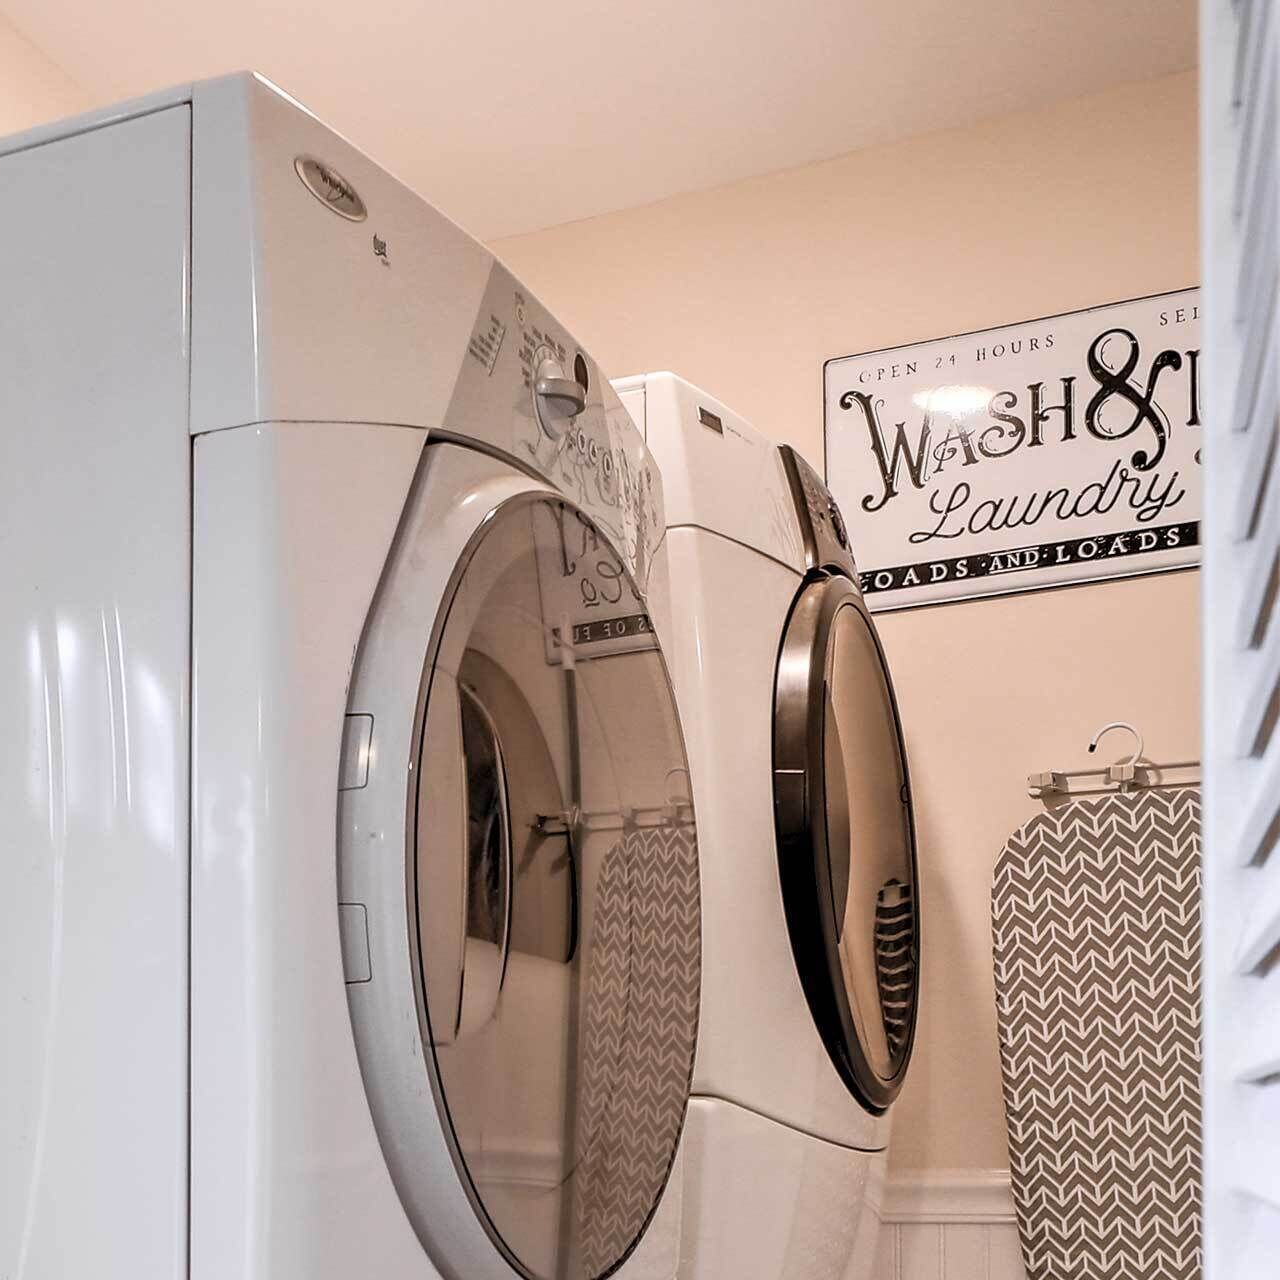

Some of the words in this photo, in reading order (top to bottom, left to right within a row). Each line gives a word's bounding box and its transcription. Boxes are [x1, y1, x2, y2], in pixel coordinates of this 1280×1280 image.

[858, 361, 919, 384] OPEN
[935, 354, 957, 370] 24
[975, 333, 1057, 362] HOURS
[839, 375, 1077, 513] WASH
[908, 459, 1186, 544] Laundry
[988, 551, 1039, 572] AND
[1055, 527, 1182, 564] LOADS
